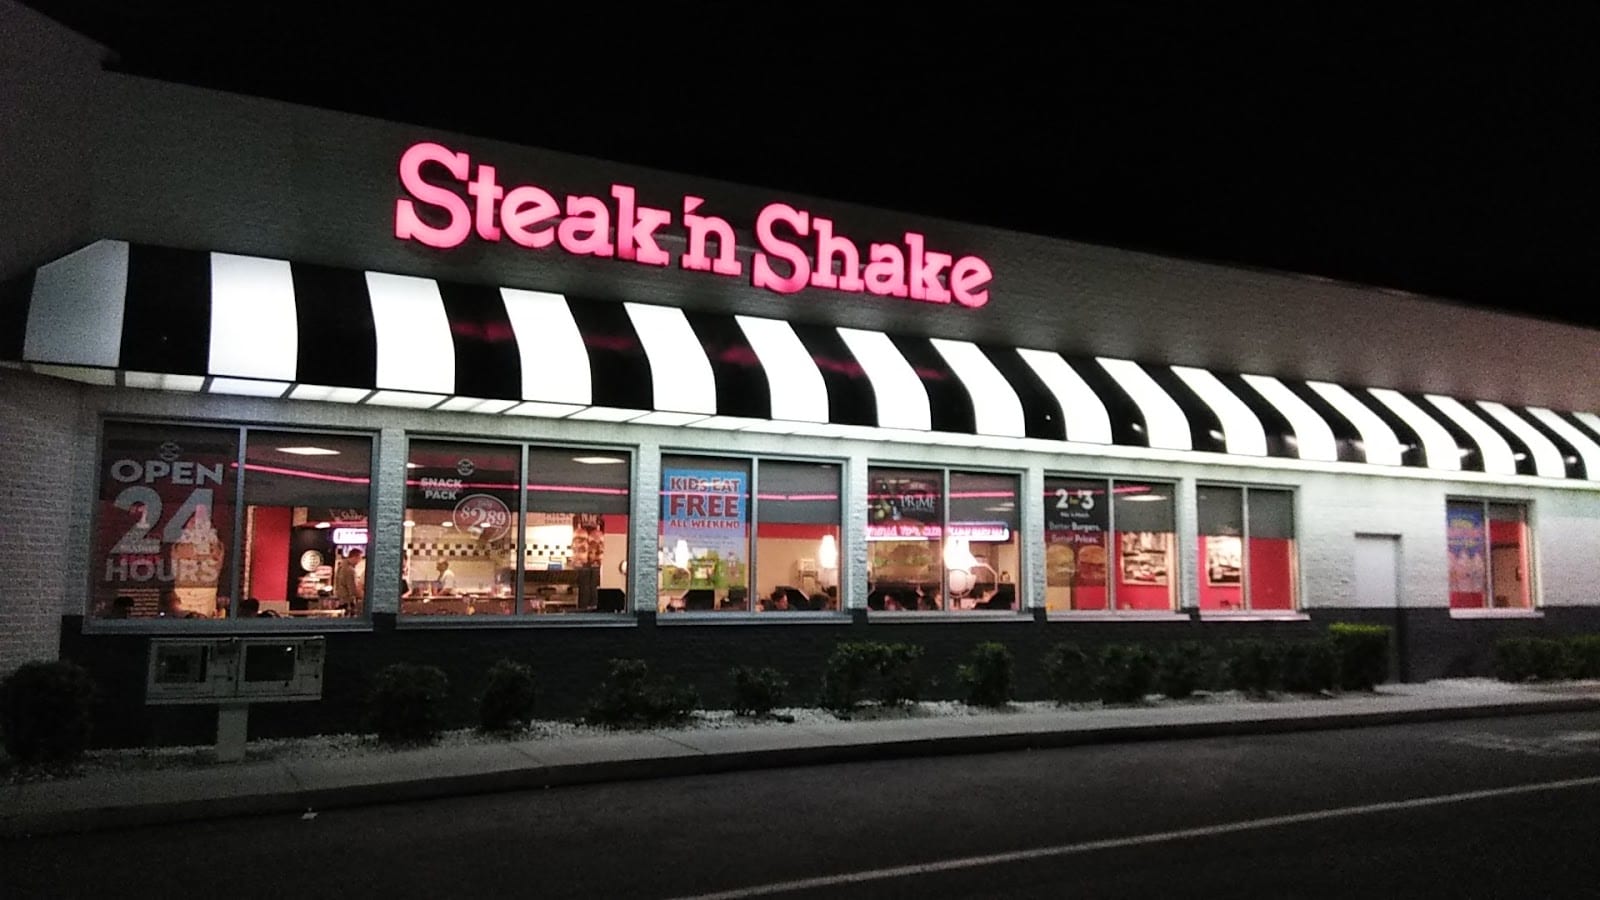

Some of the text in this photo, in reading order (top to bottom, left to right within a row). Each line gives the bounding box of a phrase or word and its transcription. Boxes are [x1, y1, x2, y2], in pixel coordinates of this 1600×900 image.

[396, 142, 670, 267] Steak
[752, 203, 993, 307] Shake
[111, 459, 224, 485] OPEN
[420, 477, 462, 488] SNACK
[425, 489, 457, 500] PACK
[671, 477, 740, 492] KIDS EAT
[670, 493, 739, 518] FREE
[1056, 488, 1068, 508] 2
[110, 486, 214, 555] 24
[670, 520, 740, 529] ALL WEEKEND
[105, 558, 219, 582] HOURS
